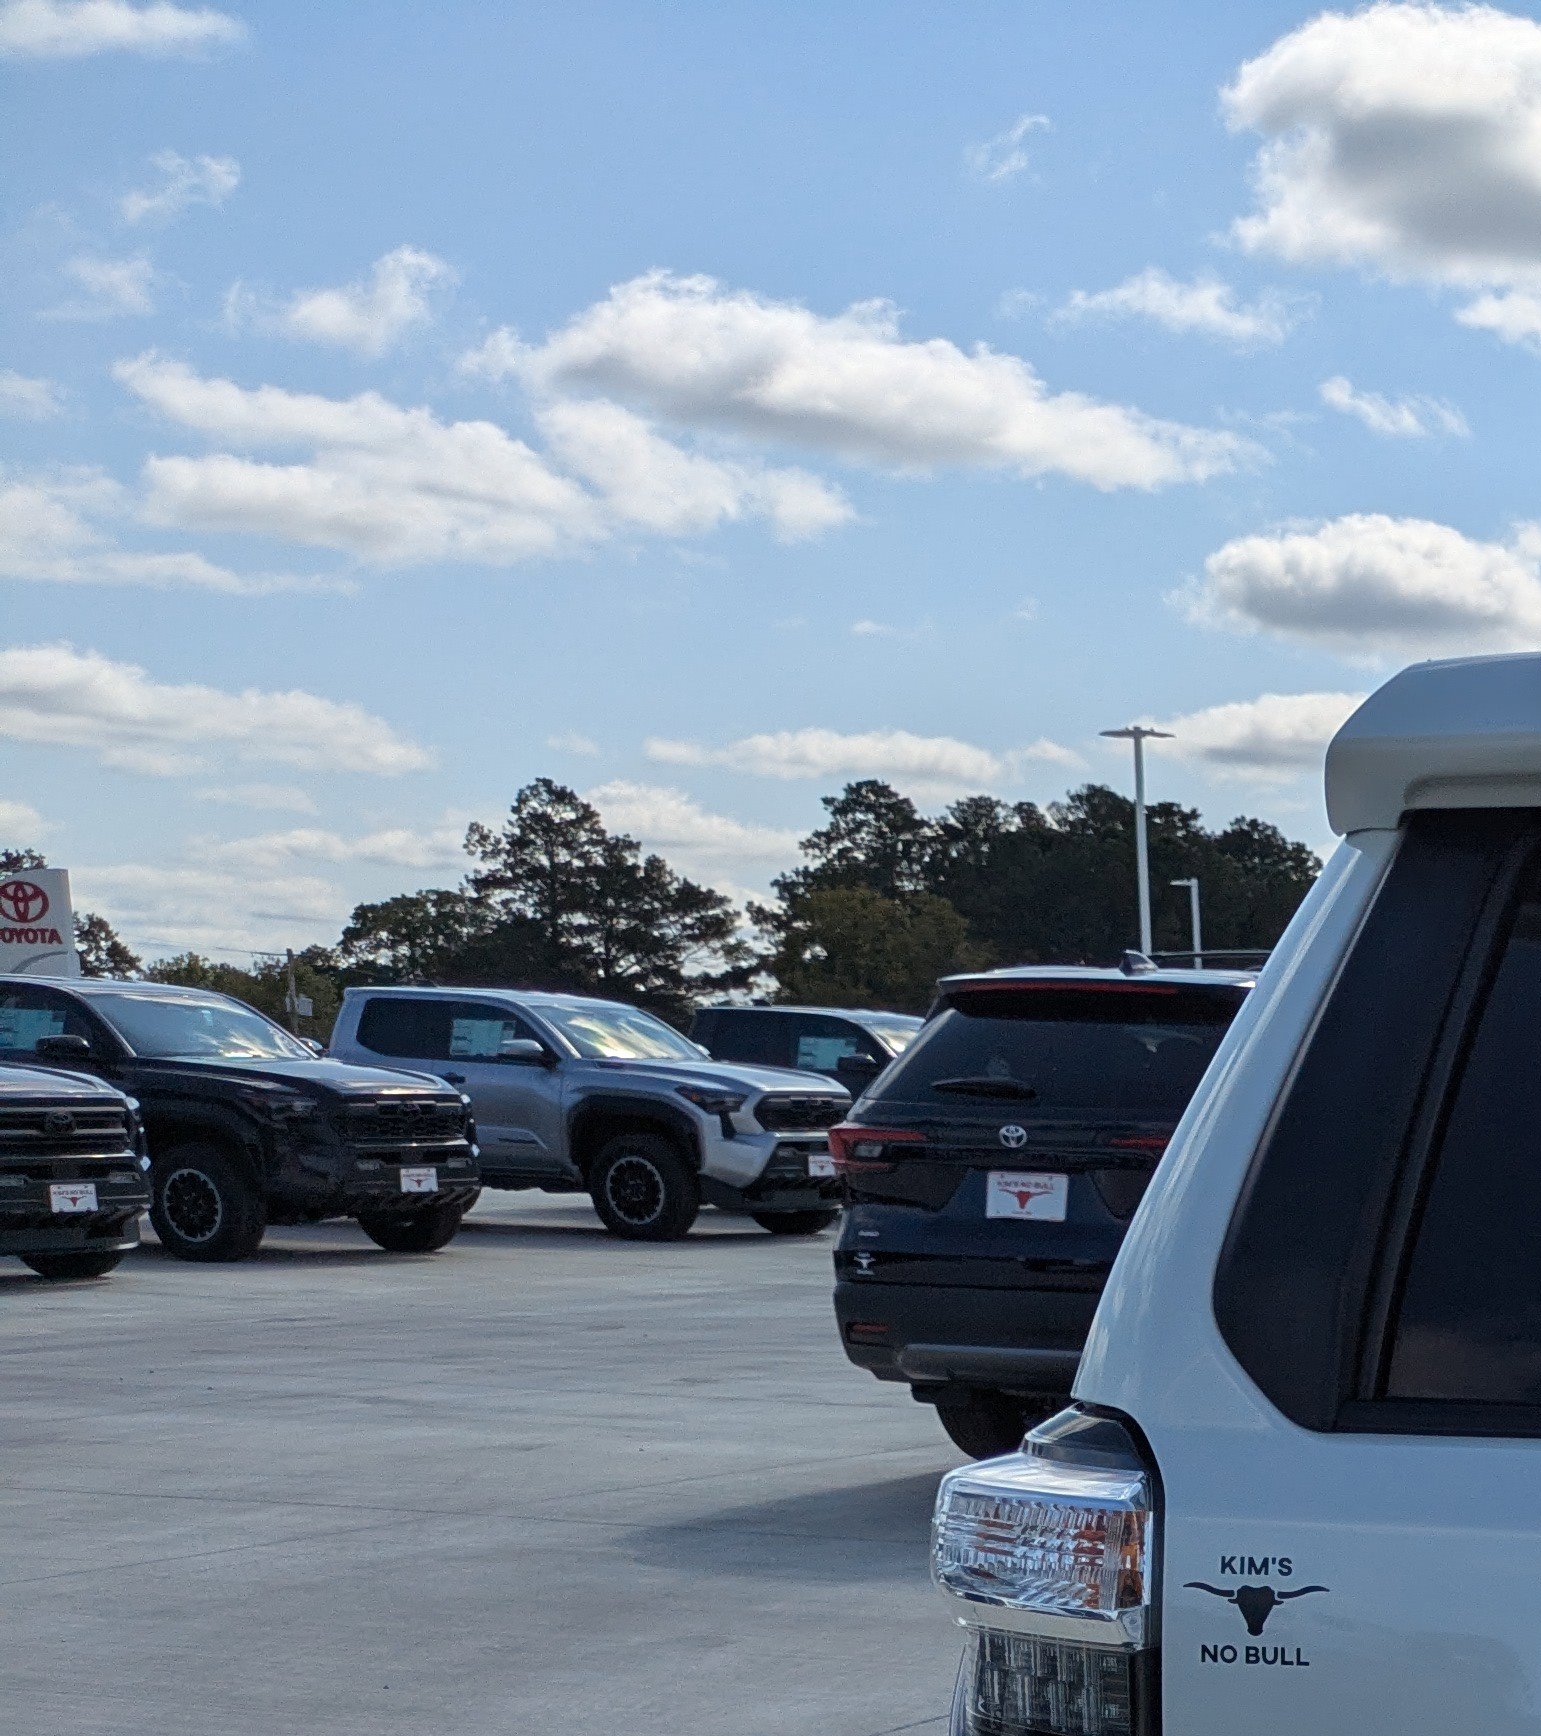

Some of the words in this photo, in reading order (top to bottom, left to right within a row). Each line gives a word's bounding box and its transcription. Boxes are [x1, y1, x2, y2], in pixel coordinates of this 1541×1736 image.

[0, 928, 63, 944] OYOTA
[1220, 1555, 1293, 1577] KIM'S
[1201, 1644, 1238, 1664] NO
[1245, 1645, 1310, 1667] BULL
